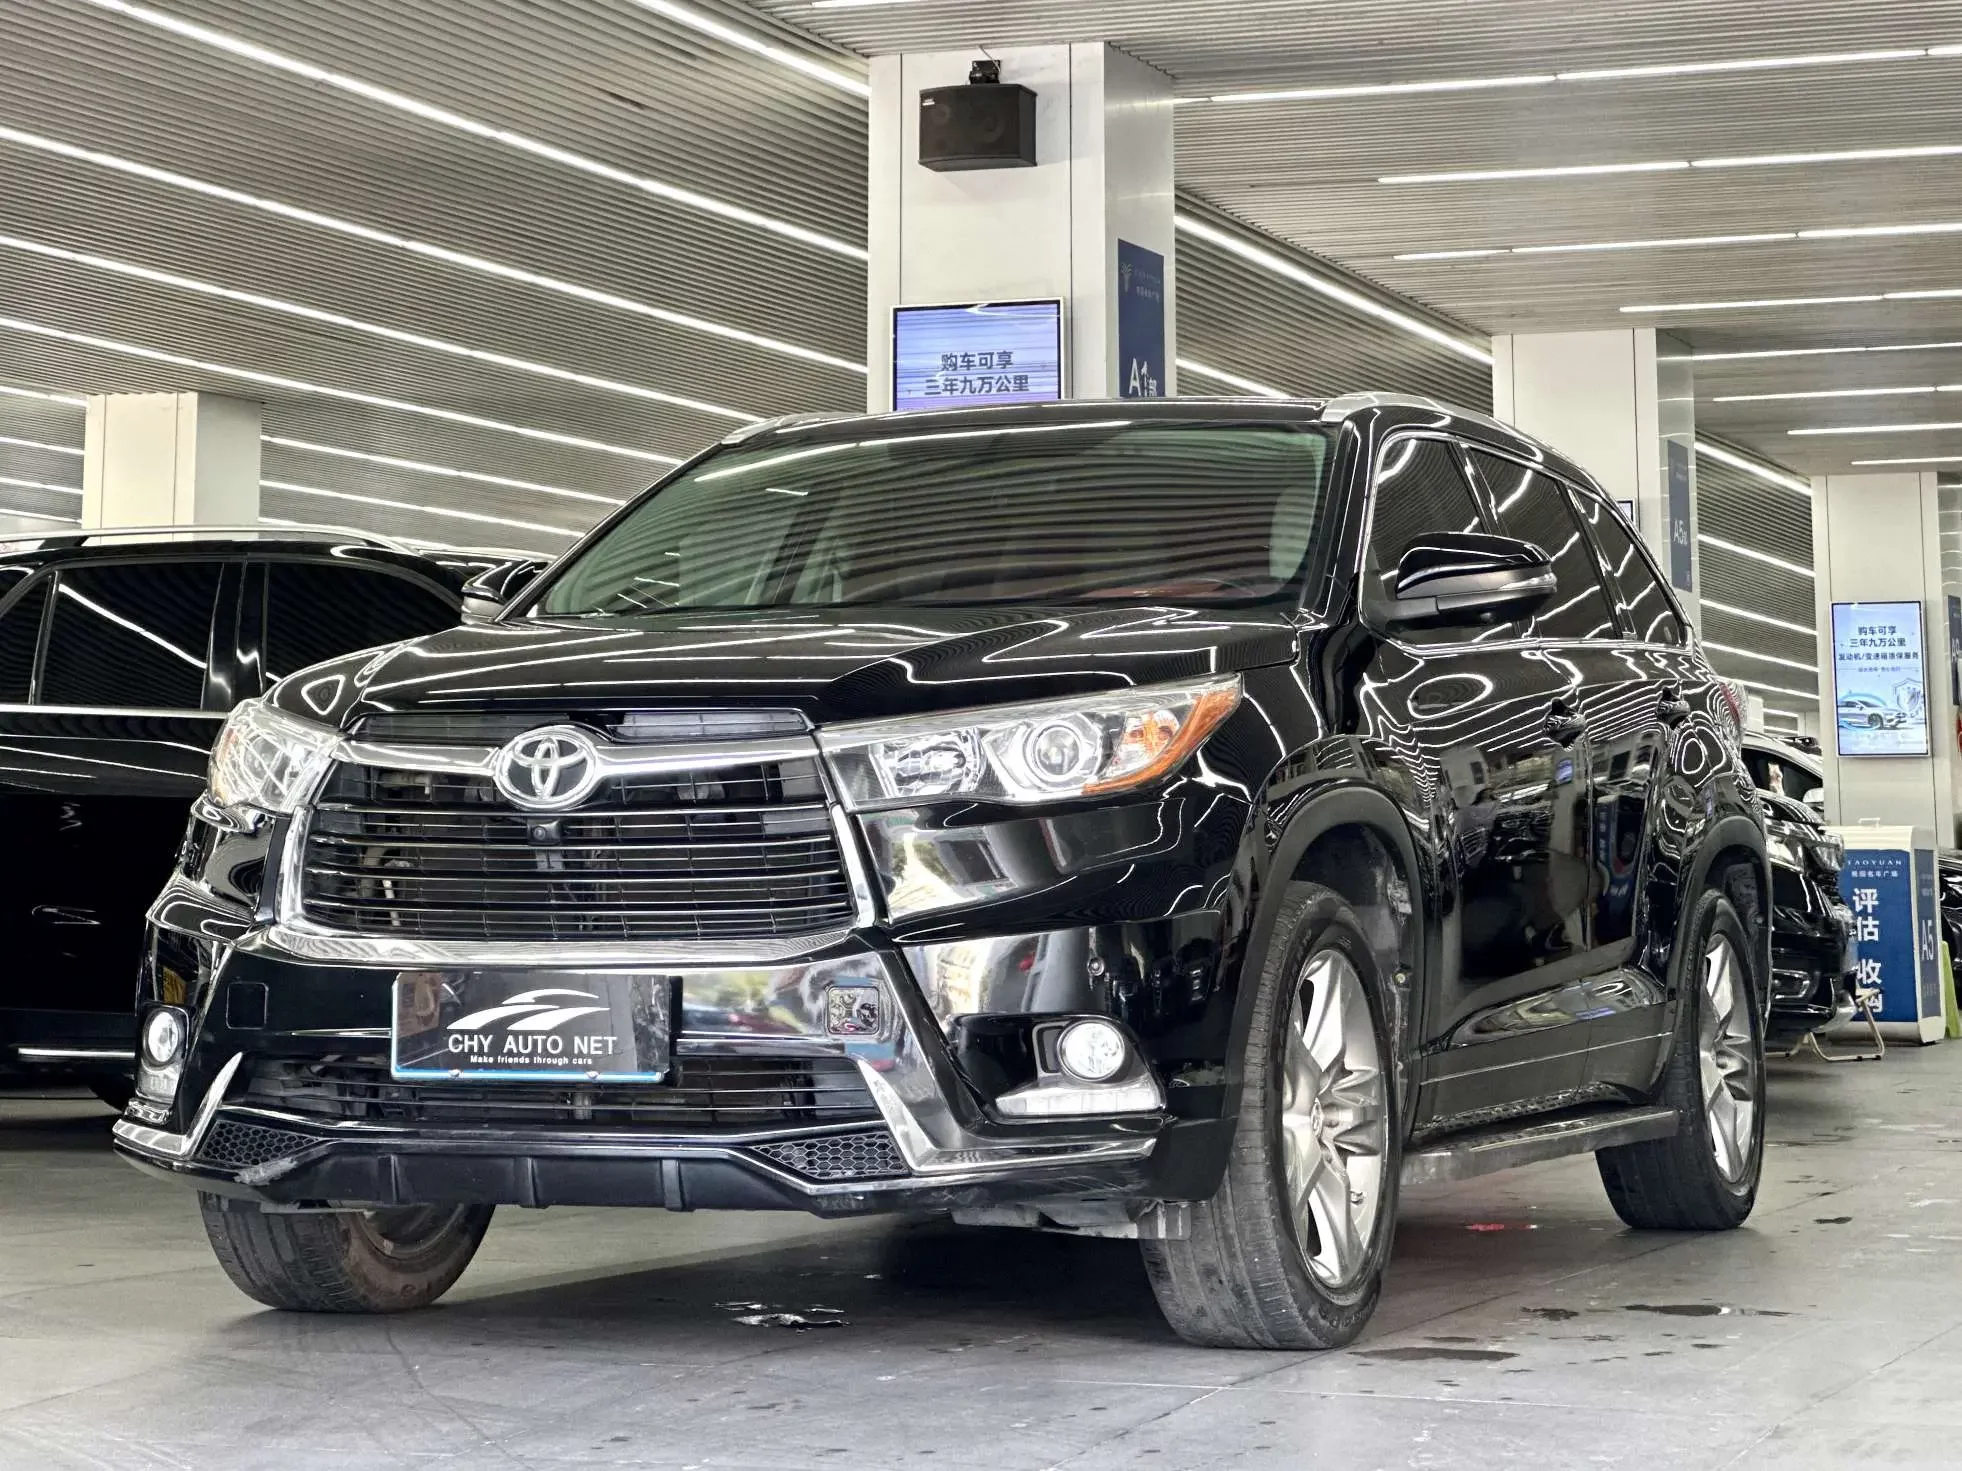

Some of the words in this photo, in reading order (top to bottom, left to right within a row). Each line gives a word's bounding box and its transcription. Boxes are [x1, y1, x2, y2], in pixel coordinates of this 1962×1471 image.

[941, 351, 1014, 372] 购车可享
[924, 374, 1030, 396] 三年九万公里
[1858, 625, 1897, 636] 购车可享
[1849, 637, 1907, 648] 三年九万公里
[1852, 887, 1880, 942] 评估
[1922, 919, 1934, 961] A5
[448, 1033, 493, 1054] CHY
[503, 1034, 563, 1055] AUTO
[574, 1035, 617, 1055] NET
[470, 1055, 493, 1064] Make
[497, 1055, 530, 1064] friends
[533, 1056, 568, 1066] through
[572, 1057, 592, 1065] cars
